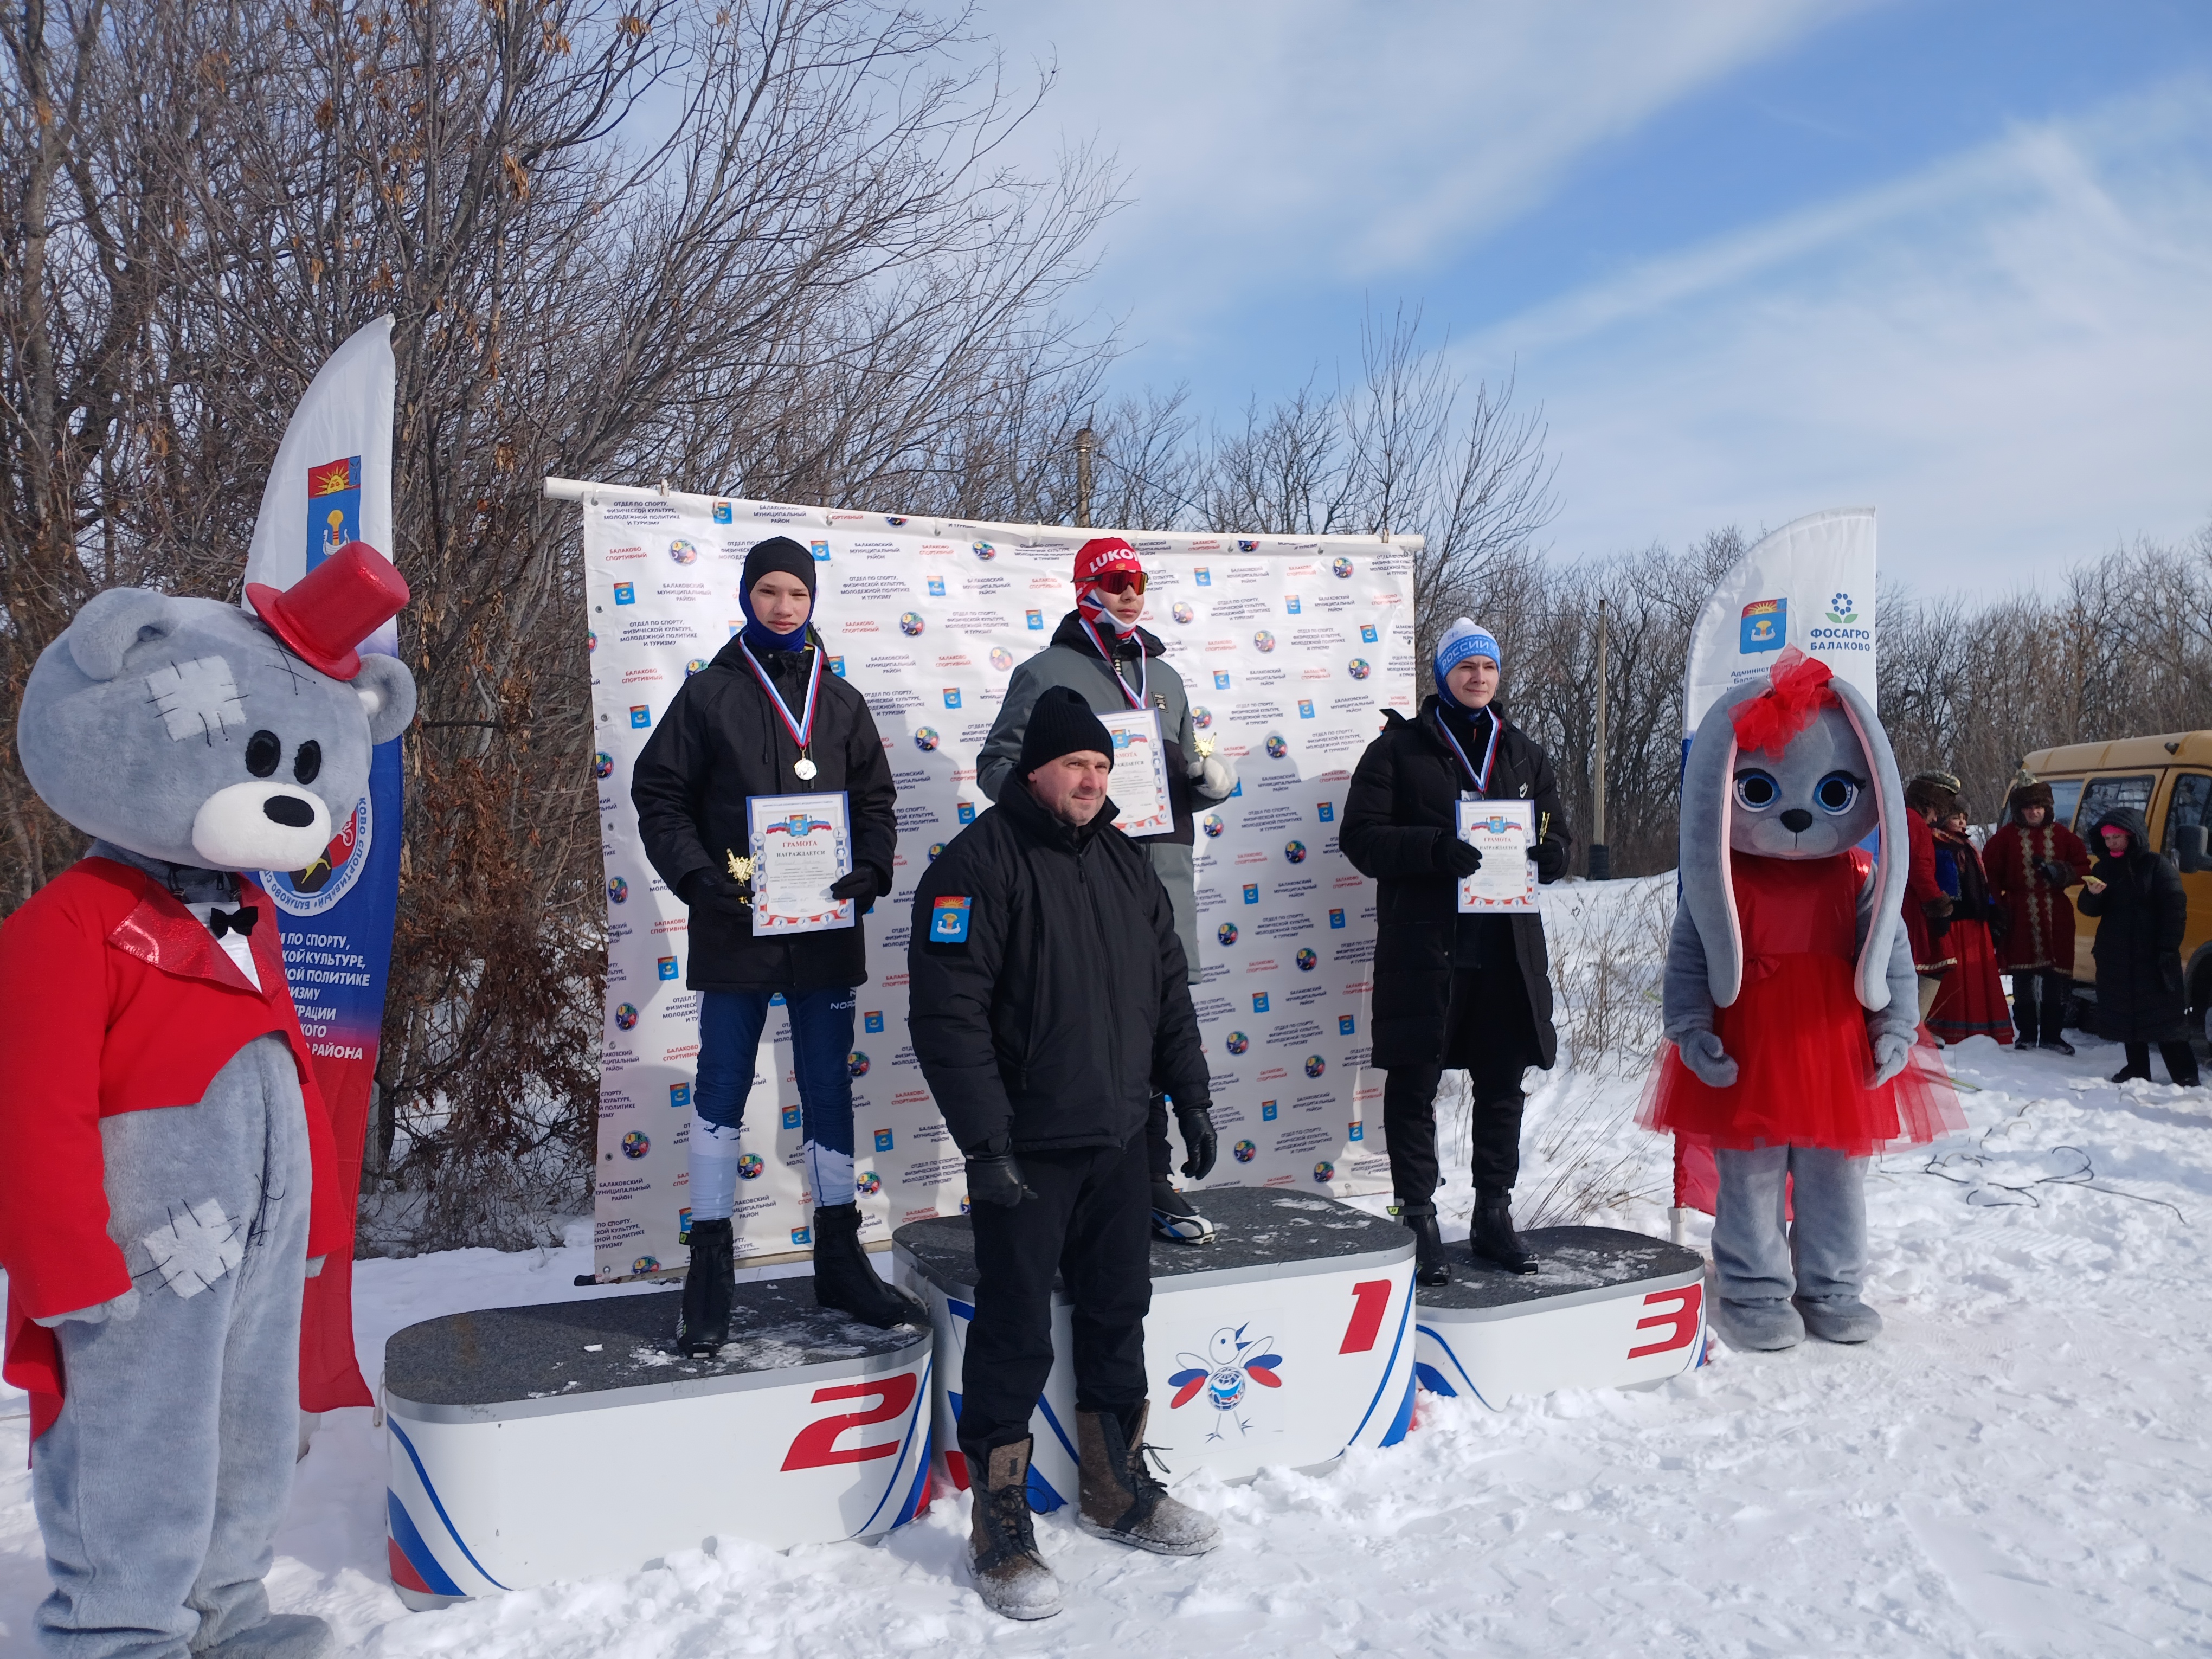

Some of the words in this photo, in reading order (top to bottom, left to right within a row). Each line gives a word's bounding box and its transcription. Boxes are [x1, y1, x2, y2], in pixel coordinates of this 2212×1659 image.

[1810, 628, 1870, 640] ФОСАГРО
[1442, 640, 1489, 668] РОССИИ
[1810, 642, 1870, 652] БАЛАКОВО
[359, 798, 367, 835] КОВО
[271, 883, 310, 910] БАЛАКОВО
[287, 933, 303, 944] ПО
[306, 934, 350, 950] СПОРТУ,
[306, 952, 366, 969] КУЛЬТУРЕ,
[307, 969, 370, 986] ПОЛИТИКЕ
[288, 987, 320, 1000] ИЗМУ
[294, 1005, 337, 1021] ТРАЦИИ
[312, 1042, 363, 1060] РАЙОНА
[891, 1096, 929, 1104] СПОРТИВНЫЙ
[599, 1179, 643, 1187] БАЛАКОВСКИЙ
[612, 1230, 645, 1239] ПОЛИТИКЕ
[1339, 1279, 1392, 1354] 1
[1627, 1283, 1702, 1359] 3
[780, 1372, 917, 1471] 2
